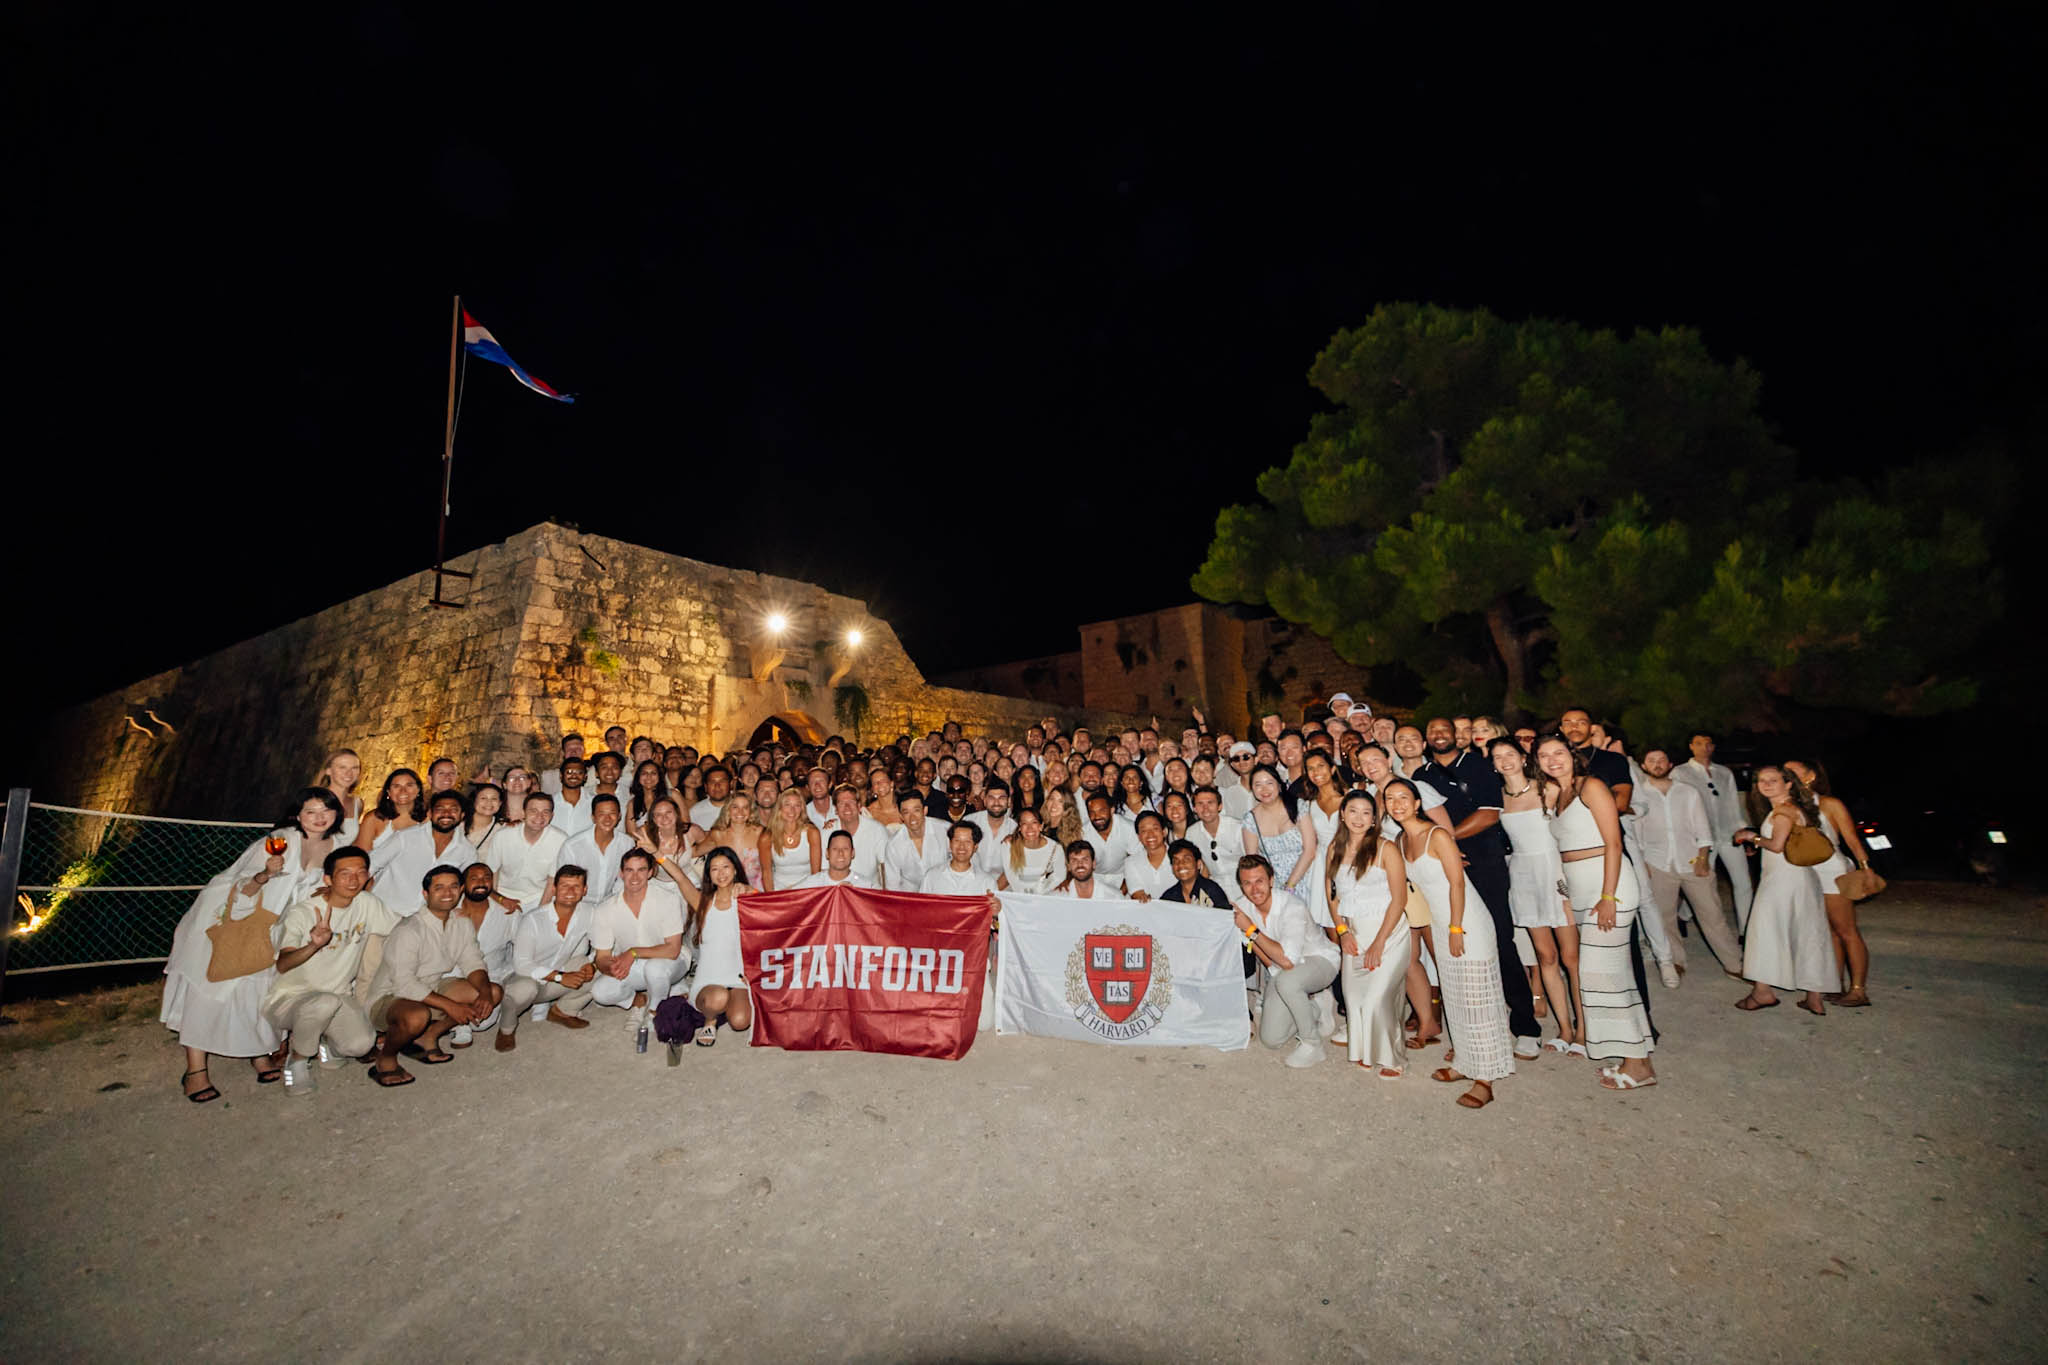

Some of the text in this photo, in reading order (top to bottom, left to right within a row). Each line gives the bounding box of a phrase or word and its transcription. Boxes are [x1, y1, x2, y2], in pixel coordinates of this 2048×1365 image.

[1095, 951, 1141, 964] VE RI
[760, 944, 965, 994] STANFORD
[1108, 985, 1129, 998] TAS
[1088, 1016, 1147, 1038] HARVARD
